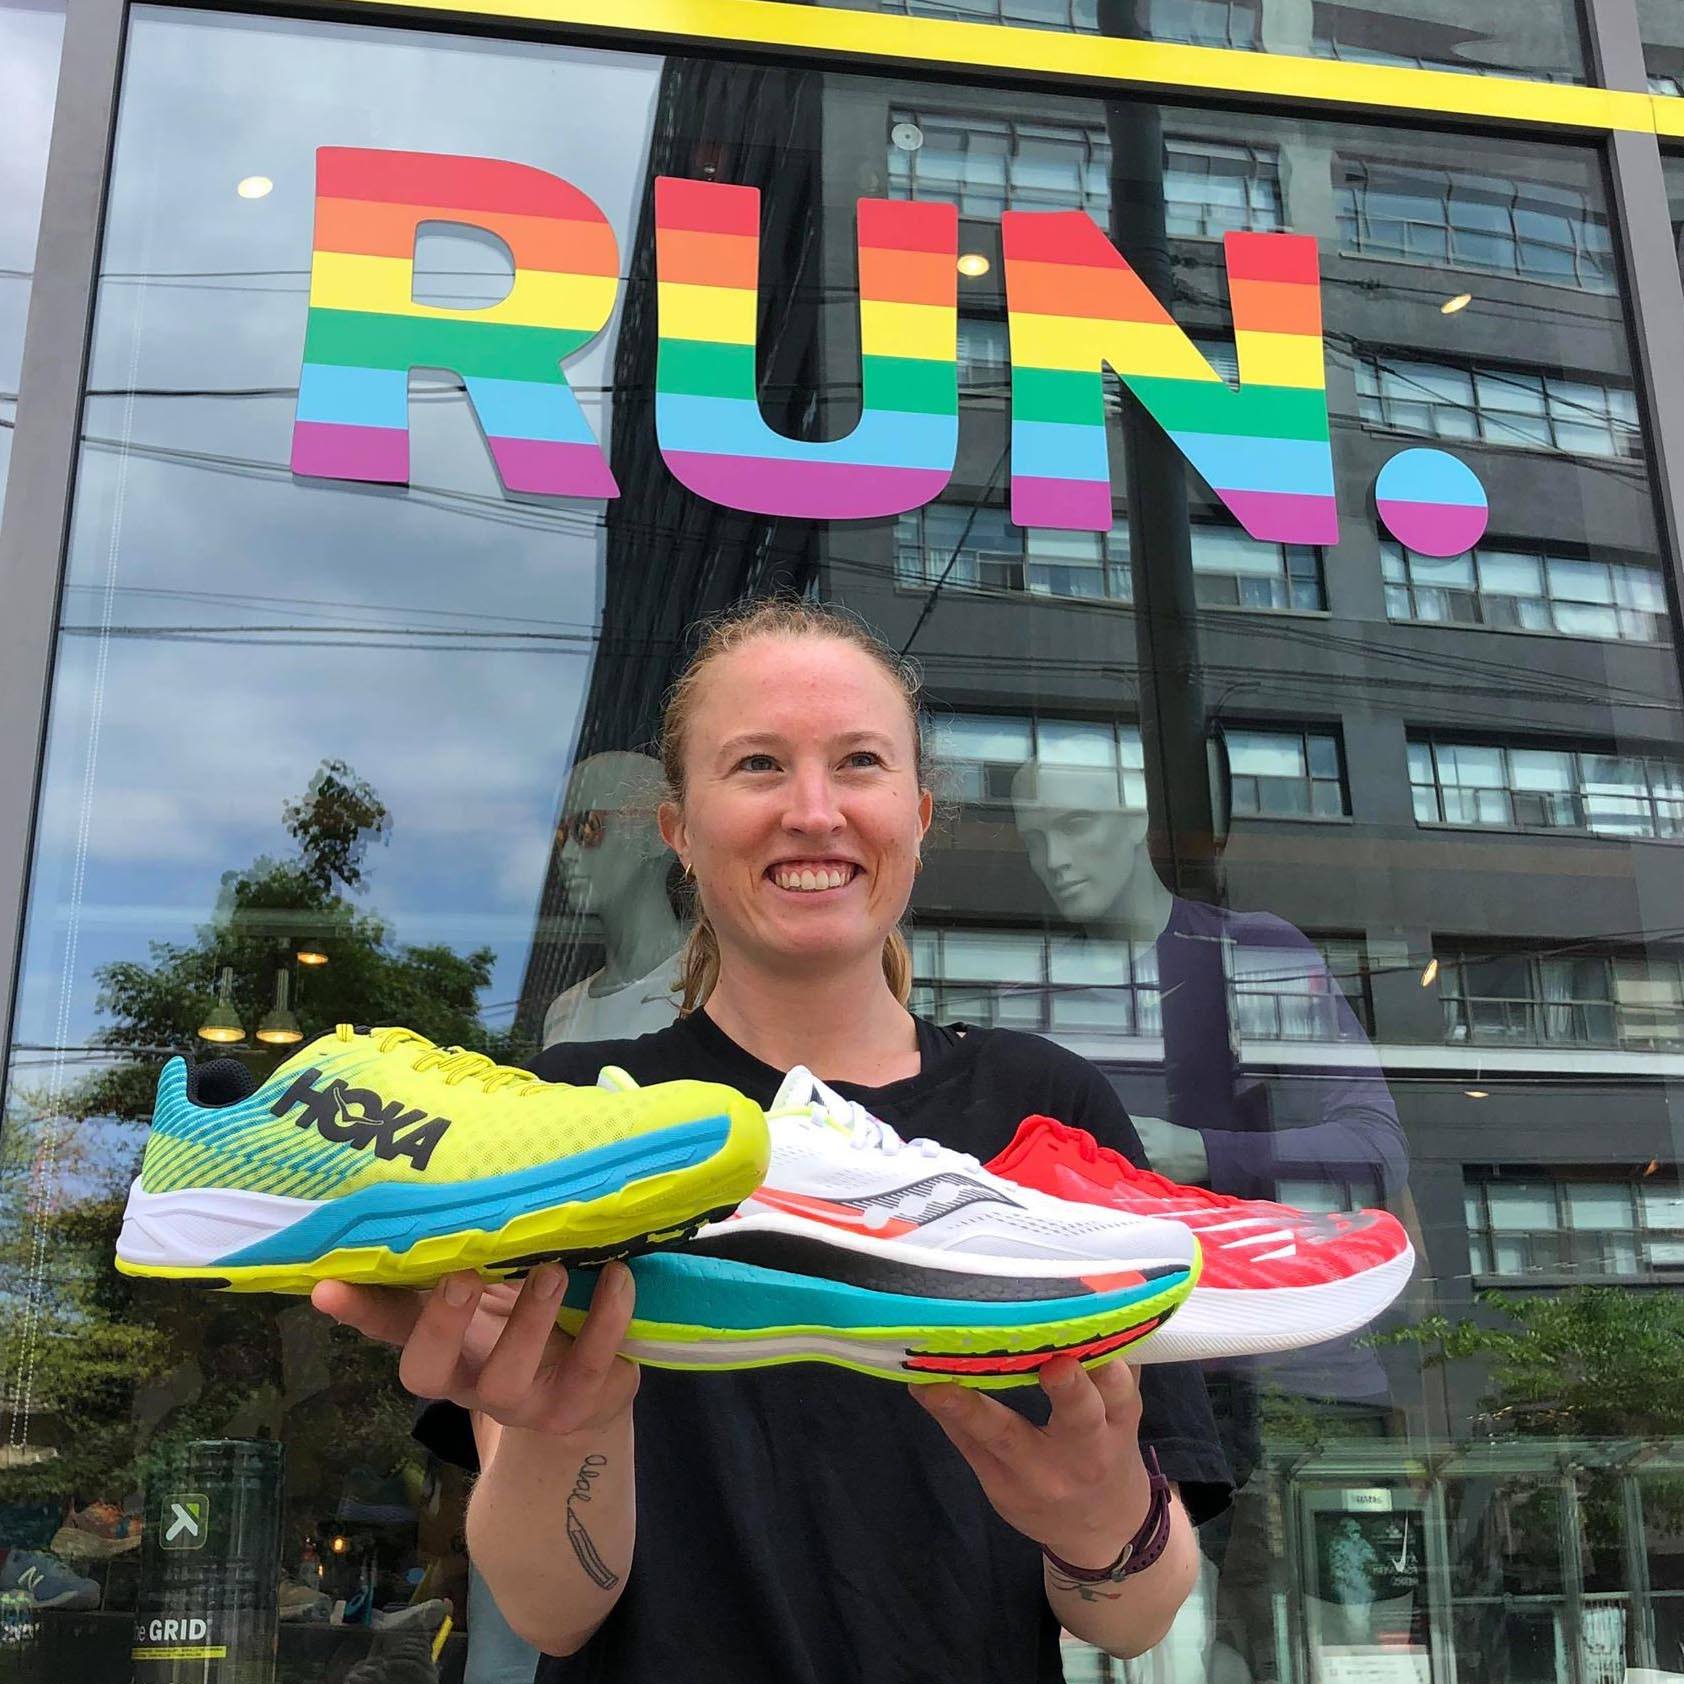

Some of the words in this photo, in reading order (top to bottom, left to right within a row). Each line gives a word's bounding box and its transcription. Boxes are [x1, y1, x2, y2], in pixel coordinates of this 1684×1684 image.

[291, 146, 1489, 557] RUN.
[270, 1067, 452, 1172] HOKA
[149, 1619, 207, 1641] GRID
